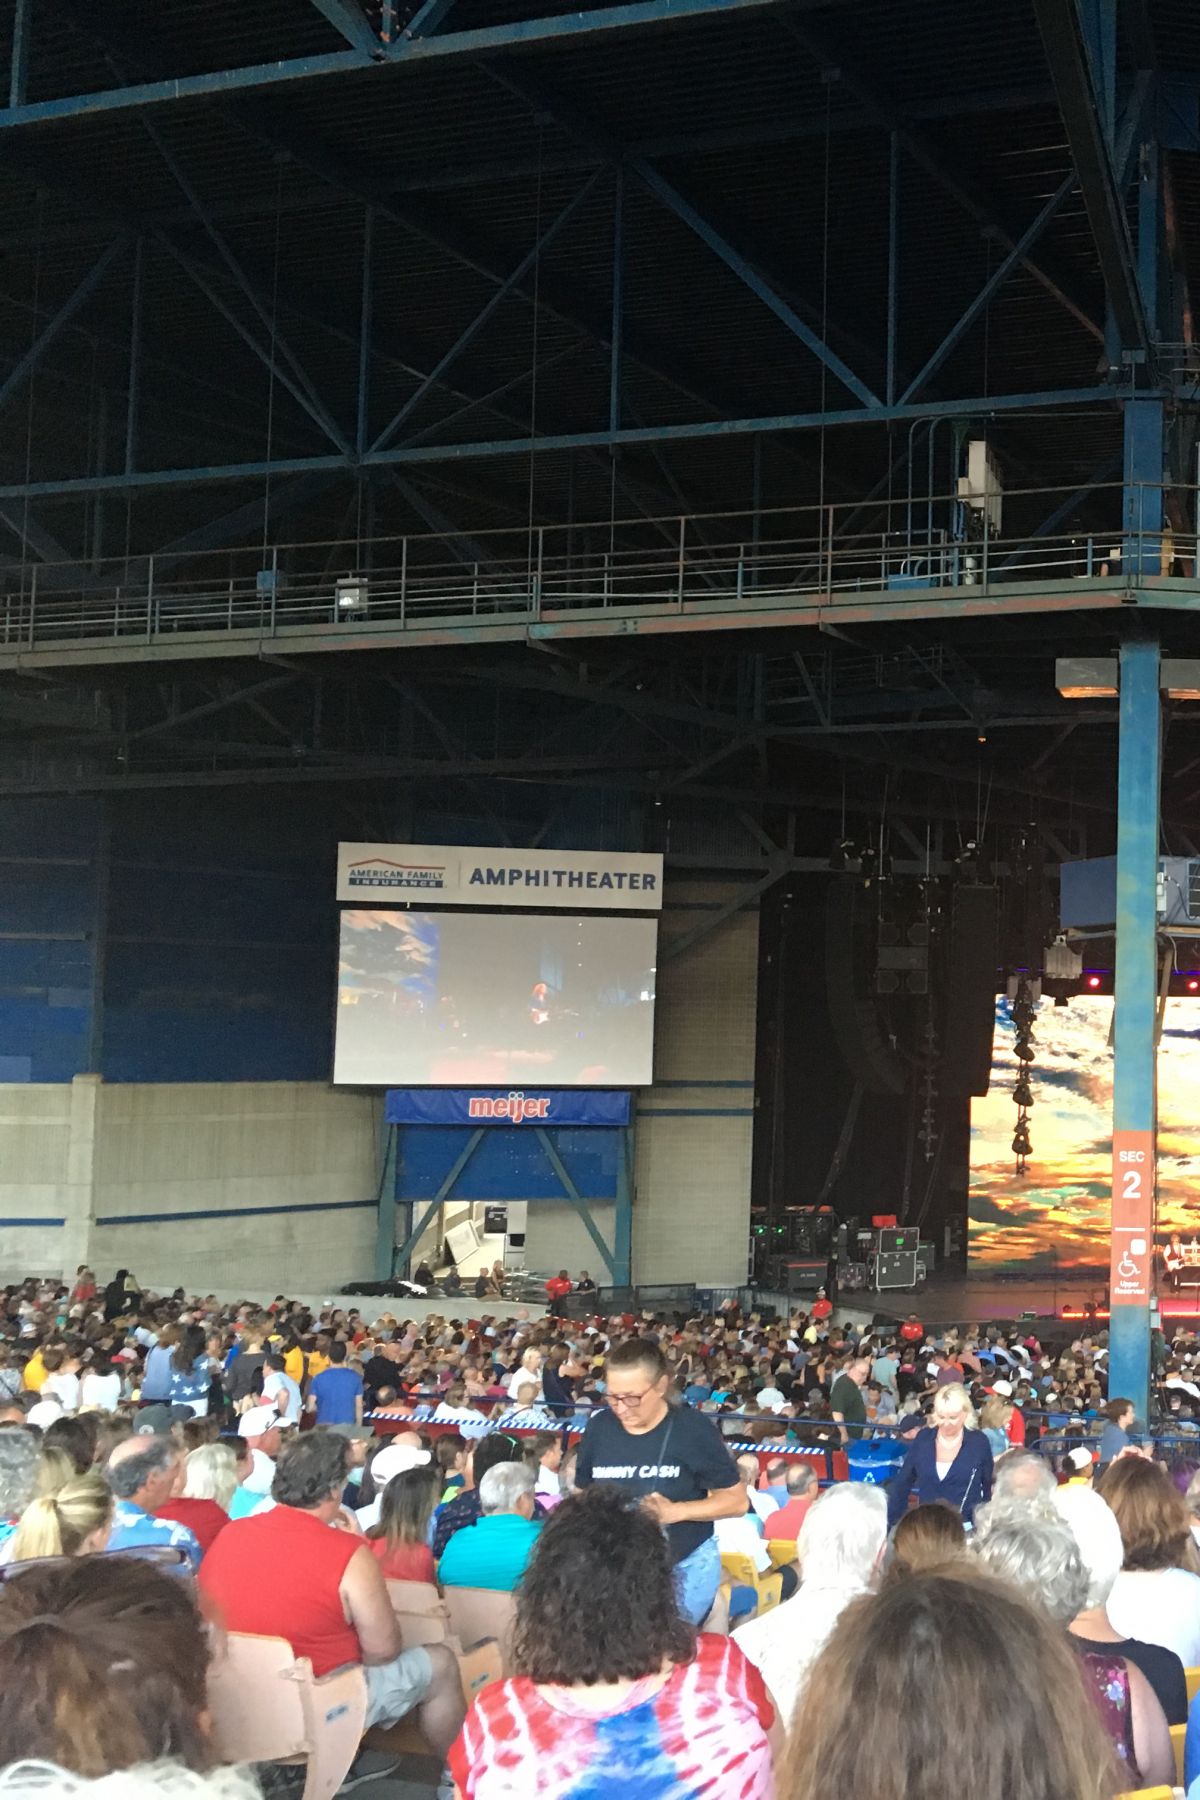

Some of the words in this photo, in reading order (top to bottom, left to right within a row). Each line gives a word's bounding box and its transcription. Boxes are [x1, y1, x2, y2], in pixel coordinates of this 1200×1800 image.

[349, 869, 403, 878] AMERICAN
[407, 871, 444, 879] FAMILY
[468, 867, 657, 891] AMPHITHEATER
[355, 879, 436, 887] INSURANCE
[469, 1091, 551, 1124] meijer
[1119, 1150, 1145, 1163] SEC
[1122, 1170, 1142, 1199] 2
[638, 1465, 680, 1478] CASH
